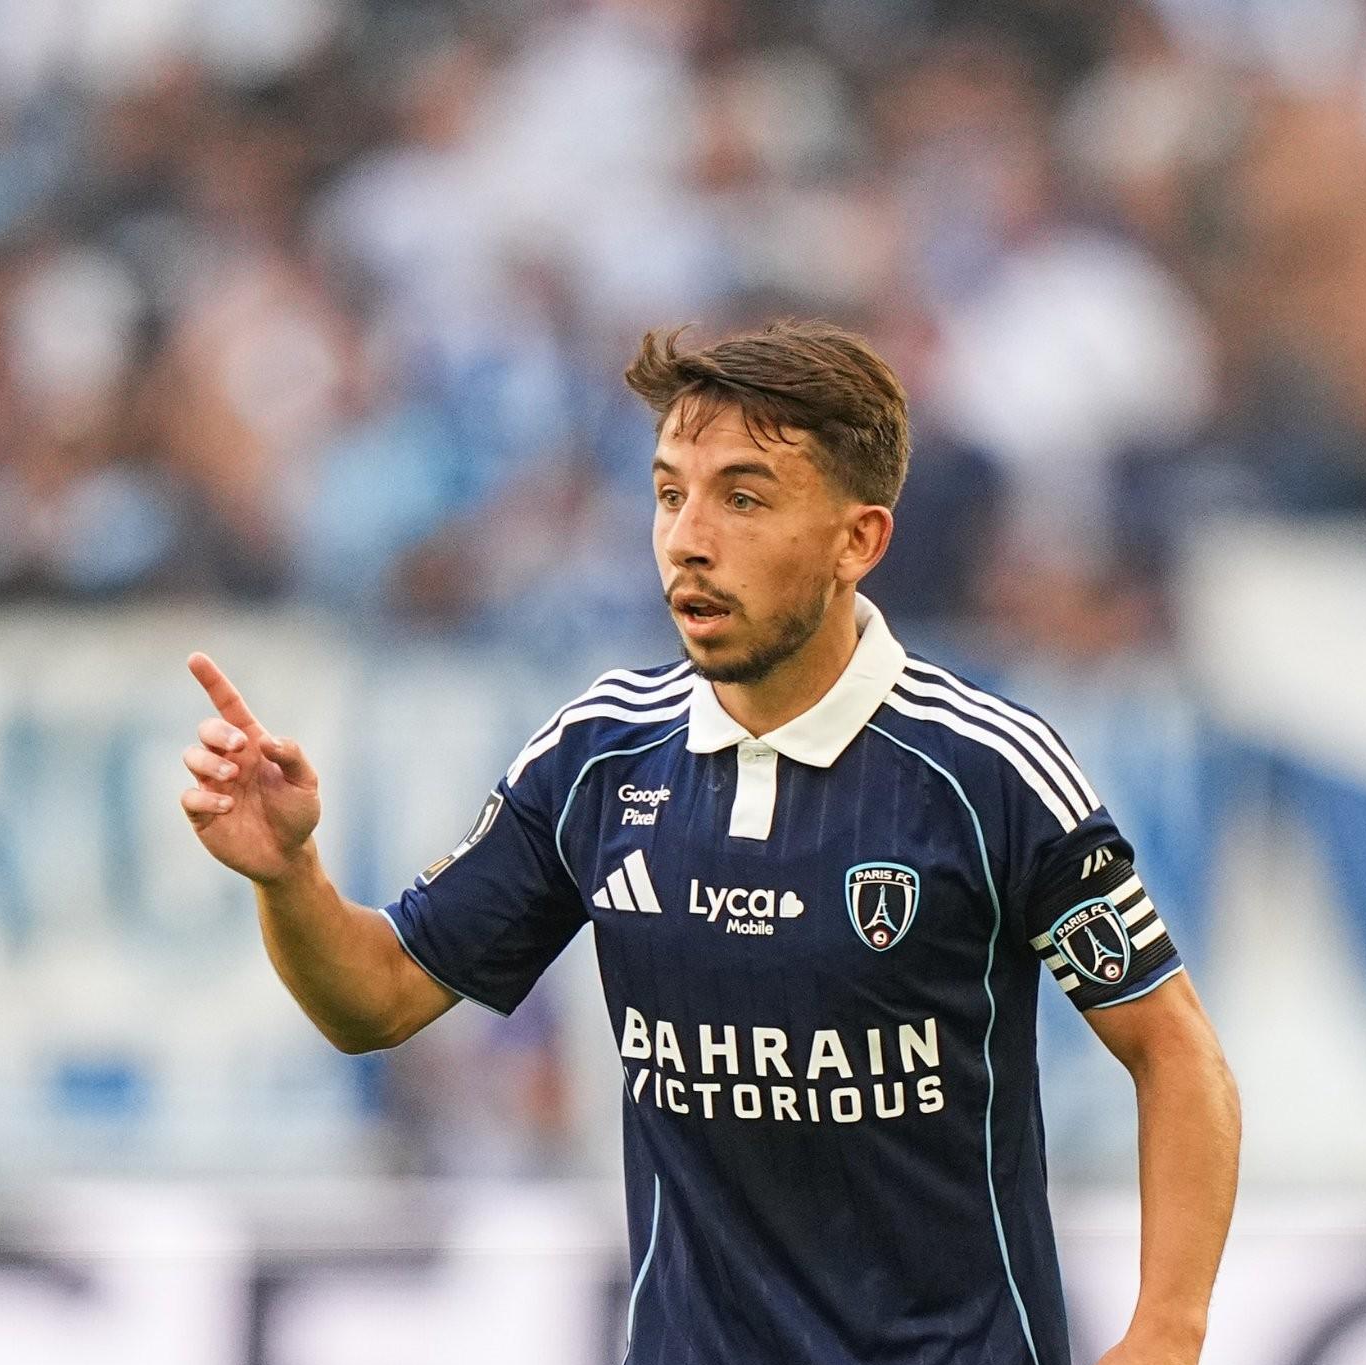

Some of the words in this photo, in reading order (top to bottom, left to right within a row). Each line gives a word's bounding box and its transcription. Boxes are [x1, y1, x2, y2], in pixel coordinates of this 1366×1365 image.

[618, 784, 671, 807] Google
[621, 808, 658, 825] Pixel
[855, 869, 893, 882] PARIS
[895, 872, 912, 885] FC
[689, 879, 775, 922] Lyca
[726, 919, 774, 936] Mobile
[1056, 911, 1089, 938] PARIS
[1090, 903, 1107, 917] FC
[620, 1006, 940, 1080] BAHRAIN
